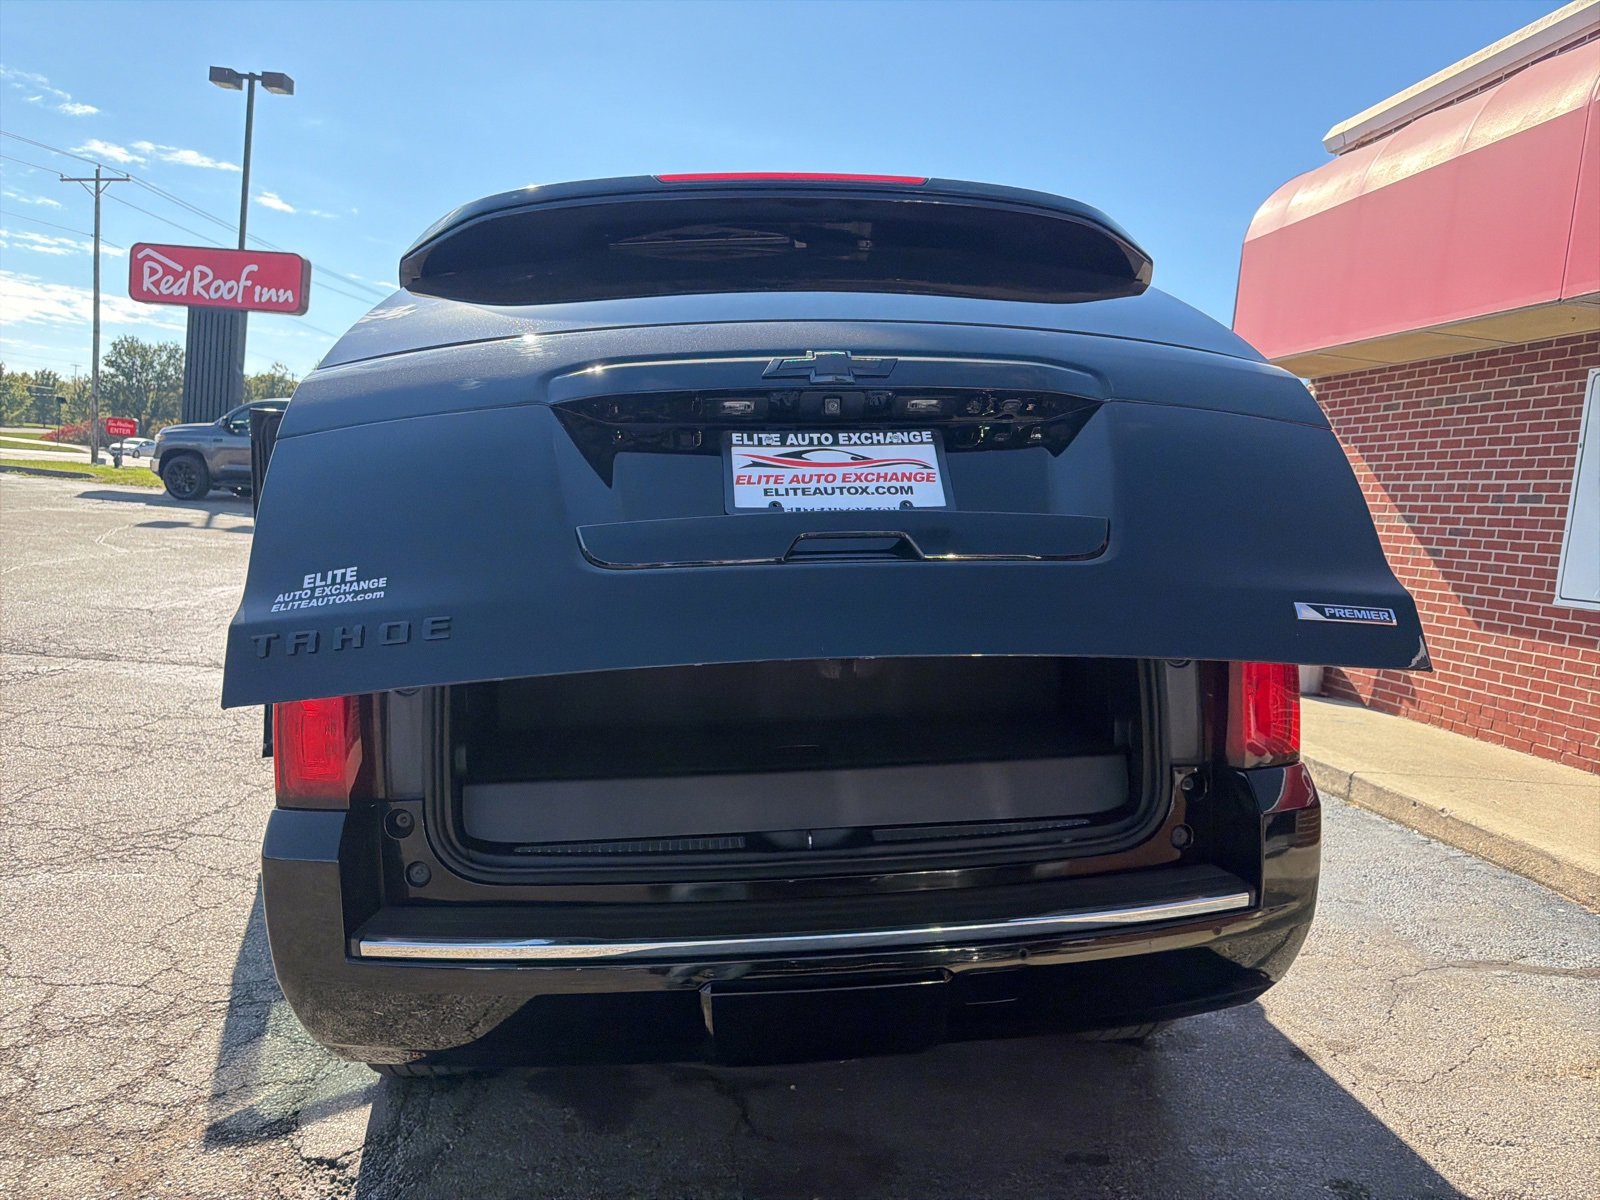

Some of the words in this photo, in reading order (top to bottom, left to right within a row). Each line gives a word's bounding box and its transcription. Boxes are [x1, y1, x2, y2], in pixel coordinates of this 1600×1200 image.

[143, 261, 191, 295] Red
[193, 264, 259, 303] Roof
[110, 427, 131, 435] ENTER
[732, 433, 781, 445] ELITE
[786, 433, 833, 445] AUTO
[839, 431, 933, 445] EXCHANGE
[735, 474, 785, 486] ELITE
[788, 473, 837, 485] AUTO
[841, 472, 937, 484] EXCHANGE
[763, 485, 914, 497] ELITEAUTOX.COM
[303, 567, 358, 589] ELITE
[274, 590, 311, 604] AUTO
[314, 577, 388, 597] EXCHANGE
[270, 591, 385, 613] ELITEAUTOX.com
[1324, 607, 1391, 621] PREMIER
[250, 616, 453, 659] TAHOE
